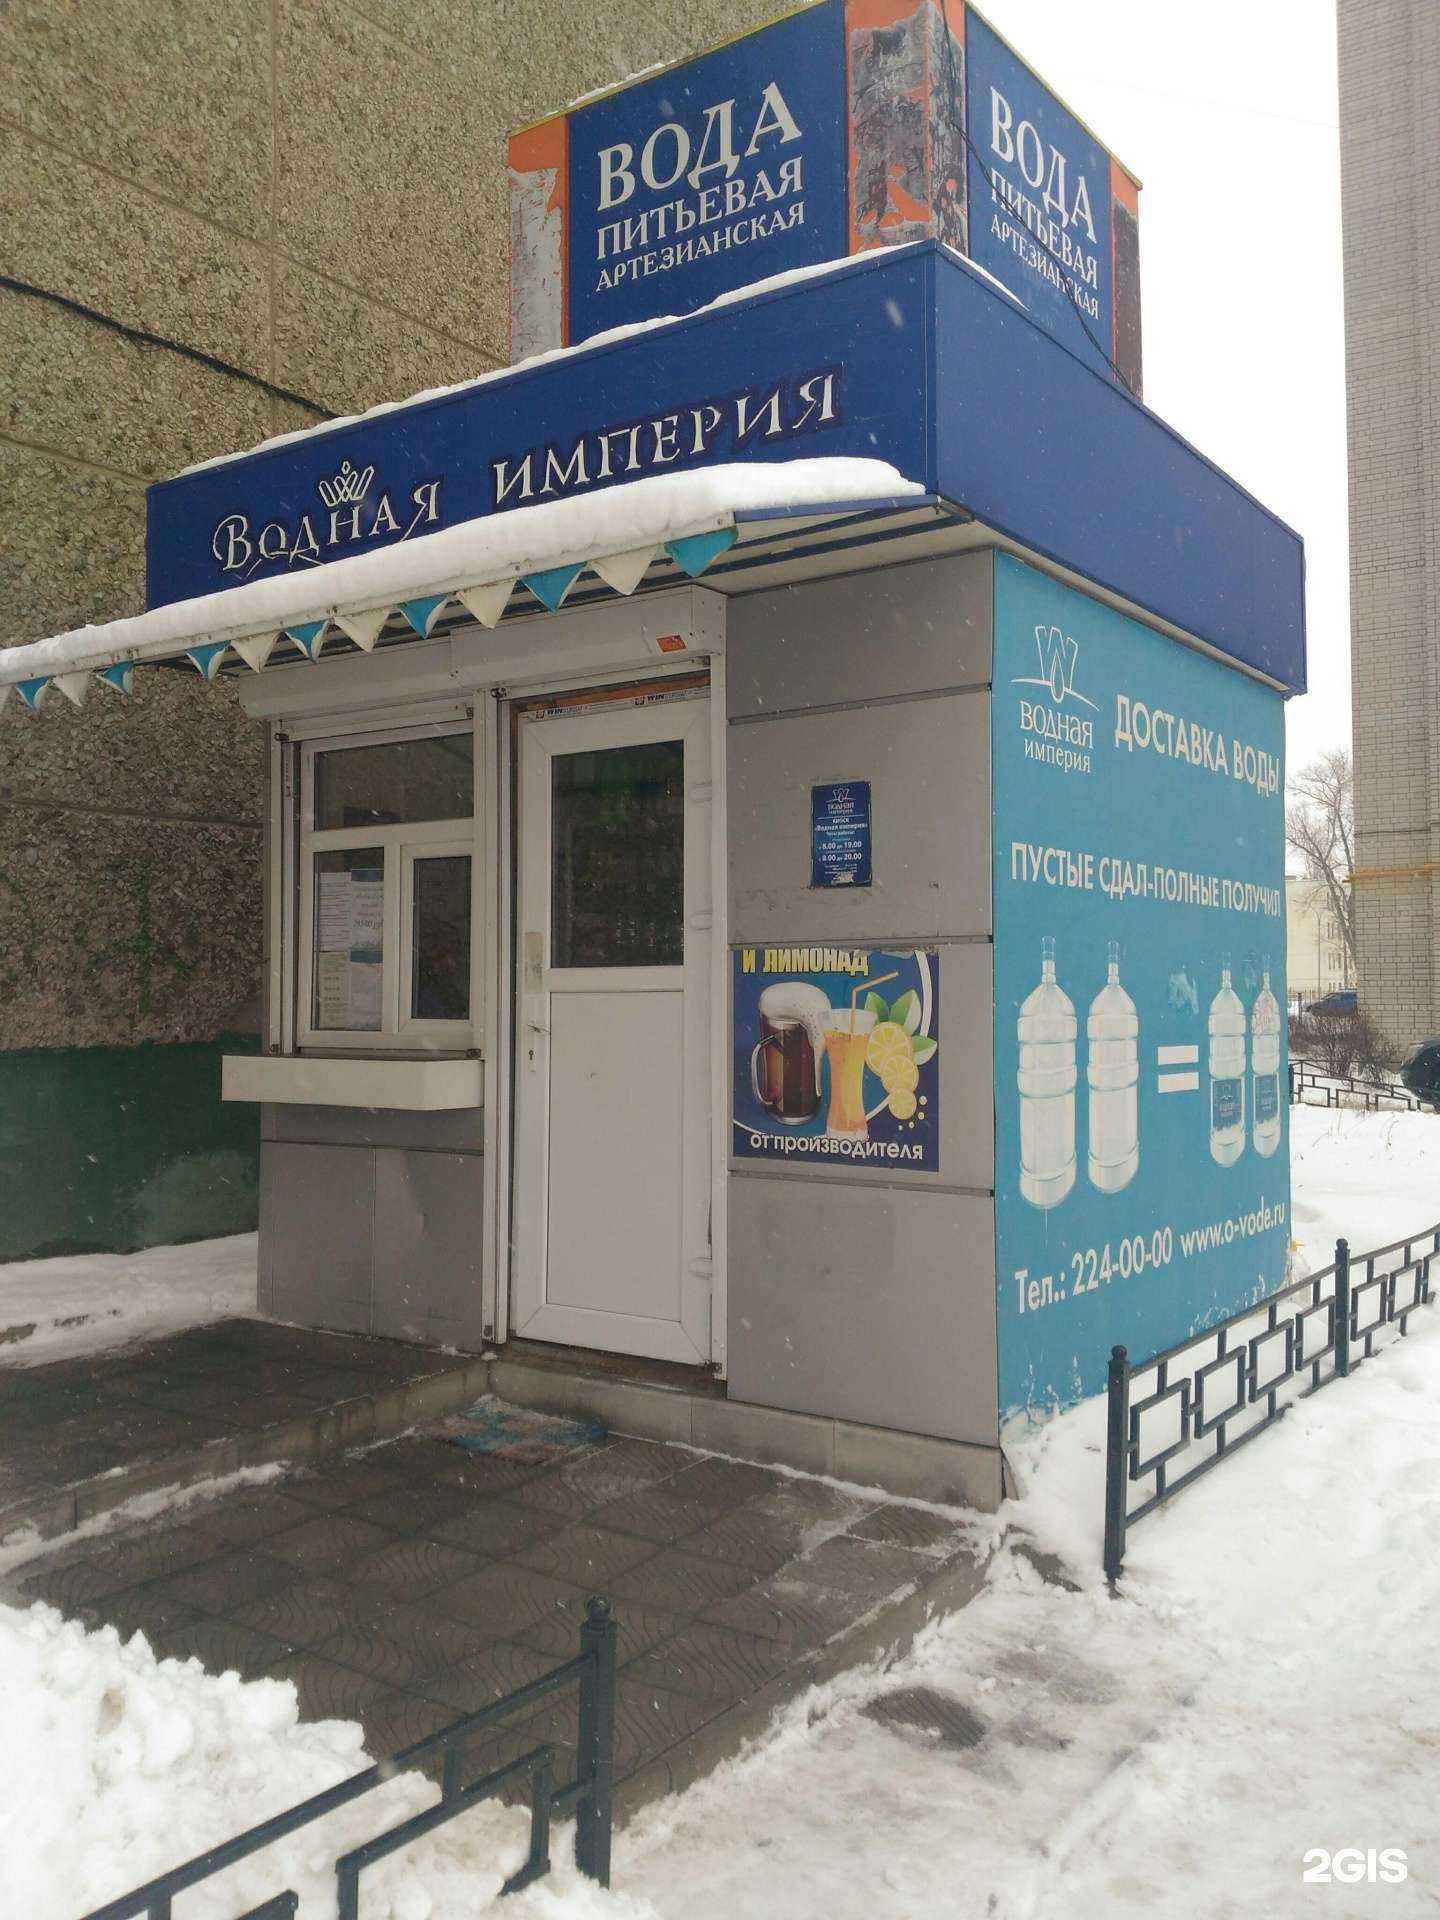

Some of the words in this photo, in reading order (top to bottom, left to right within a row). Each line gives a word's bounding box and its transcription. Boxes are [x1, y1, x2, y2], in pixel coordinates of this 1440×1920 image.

[597, 82, 802, 211] ВОДА
[990, 86, 1098, 244] ВОДА
[595, 201, 805, 292] АРТЕЗИАНСКАЯ
[597, 155, 803, 260] ПИТЬЕВАЯ
[990, 168, 1098, 290] ПИТЬЕВАЯ
[491, 373, 836, 504] ИМПЕРИЯ
[1114, 694, 1229, 776] ДОСТАВКА
[1232, 739, 1280, 798] ВОДЫ
[1011, 842, 1094, 890] ПУСТЫЕ
[1221, 879, 1281, 918] ПОЛУЧИЛ
[742, 948, 756, 975] И
[762, 947, 870, 977] ЛИМОНАД
[1014, 1268, 1067, 1314] Тел.:
[1071, 1226, 1173, 1297] 224-00-00
[1180, 1195, 1286, 1258] www.o-vode.ru
